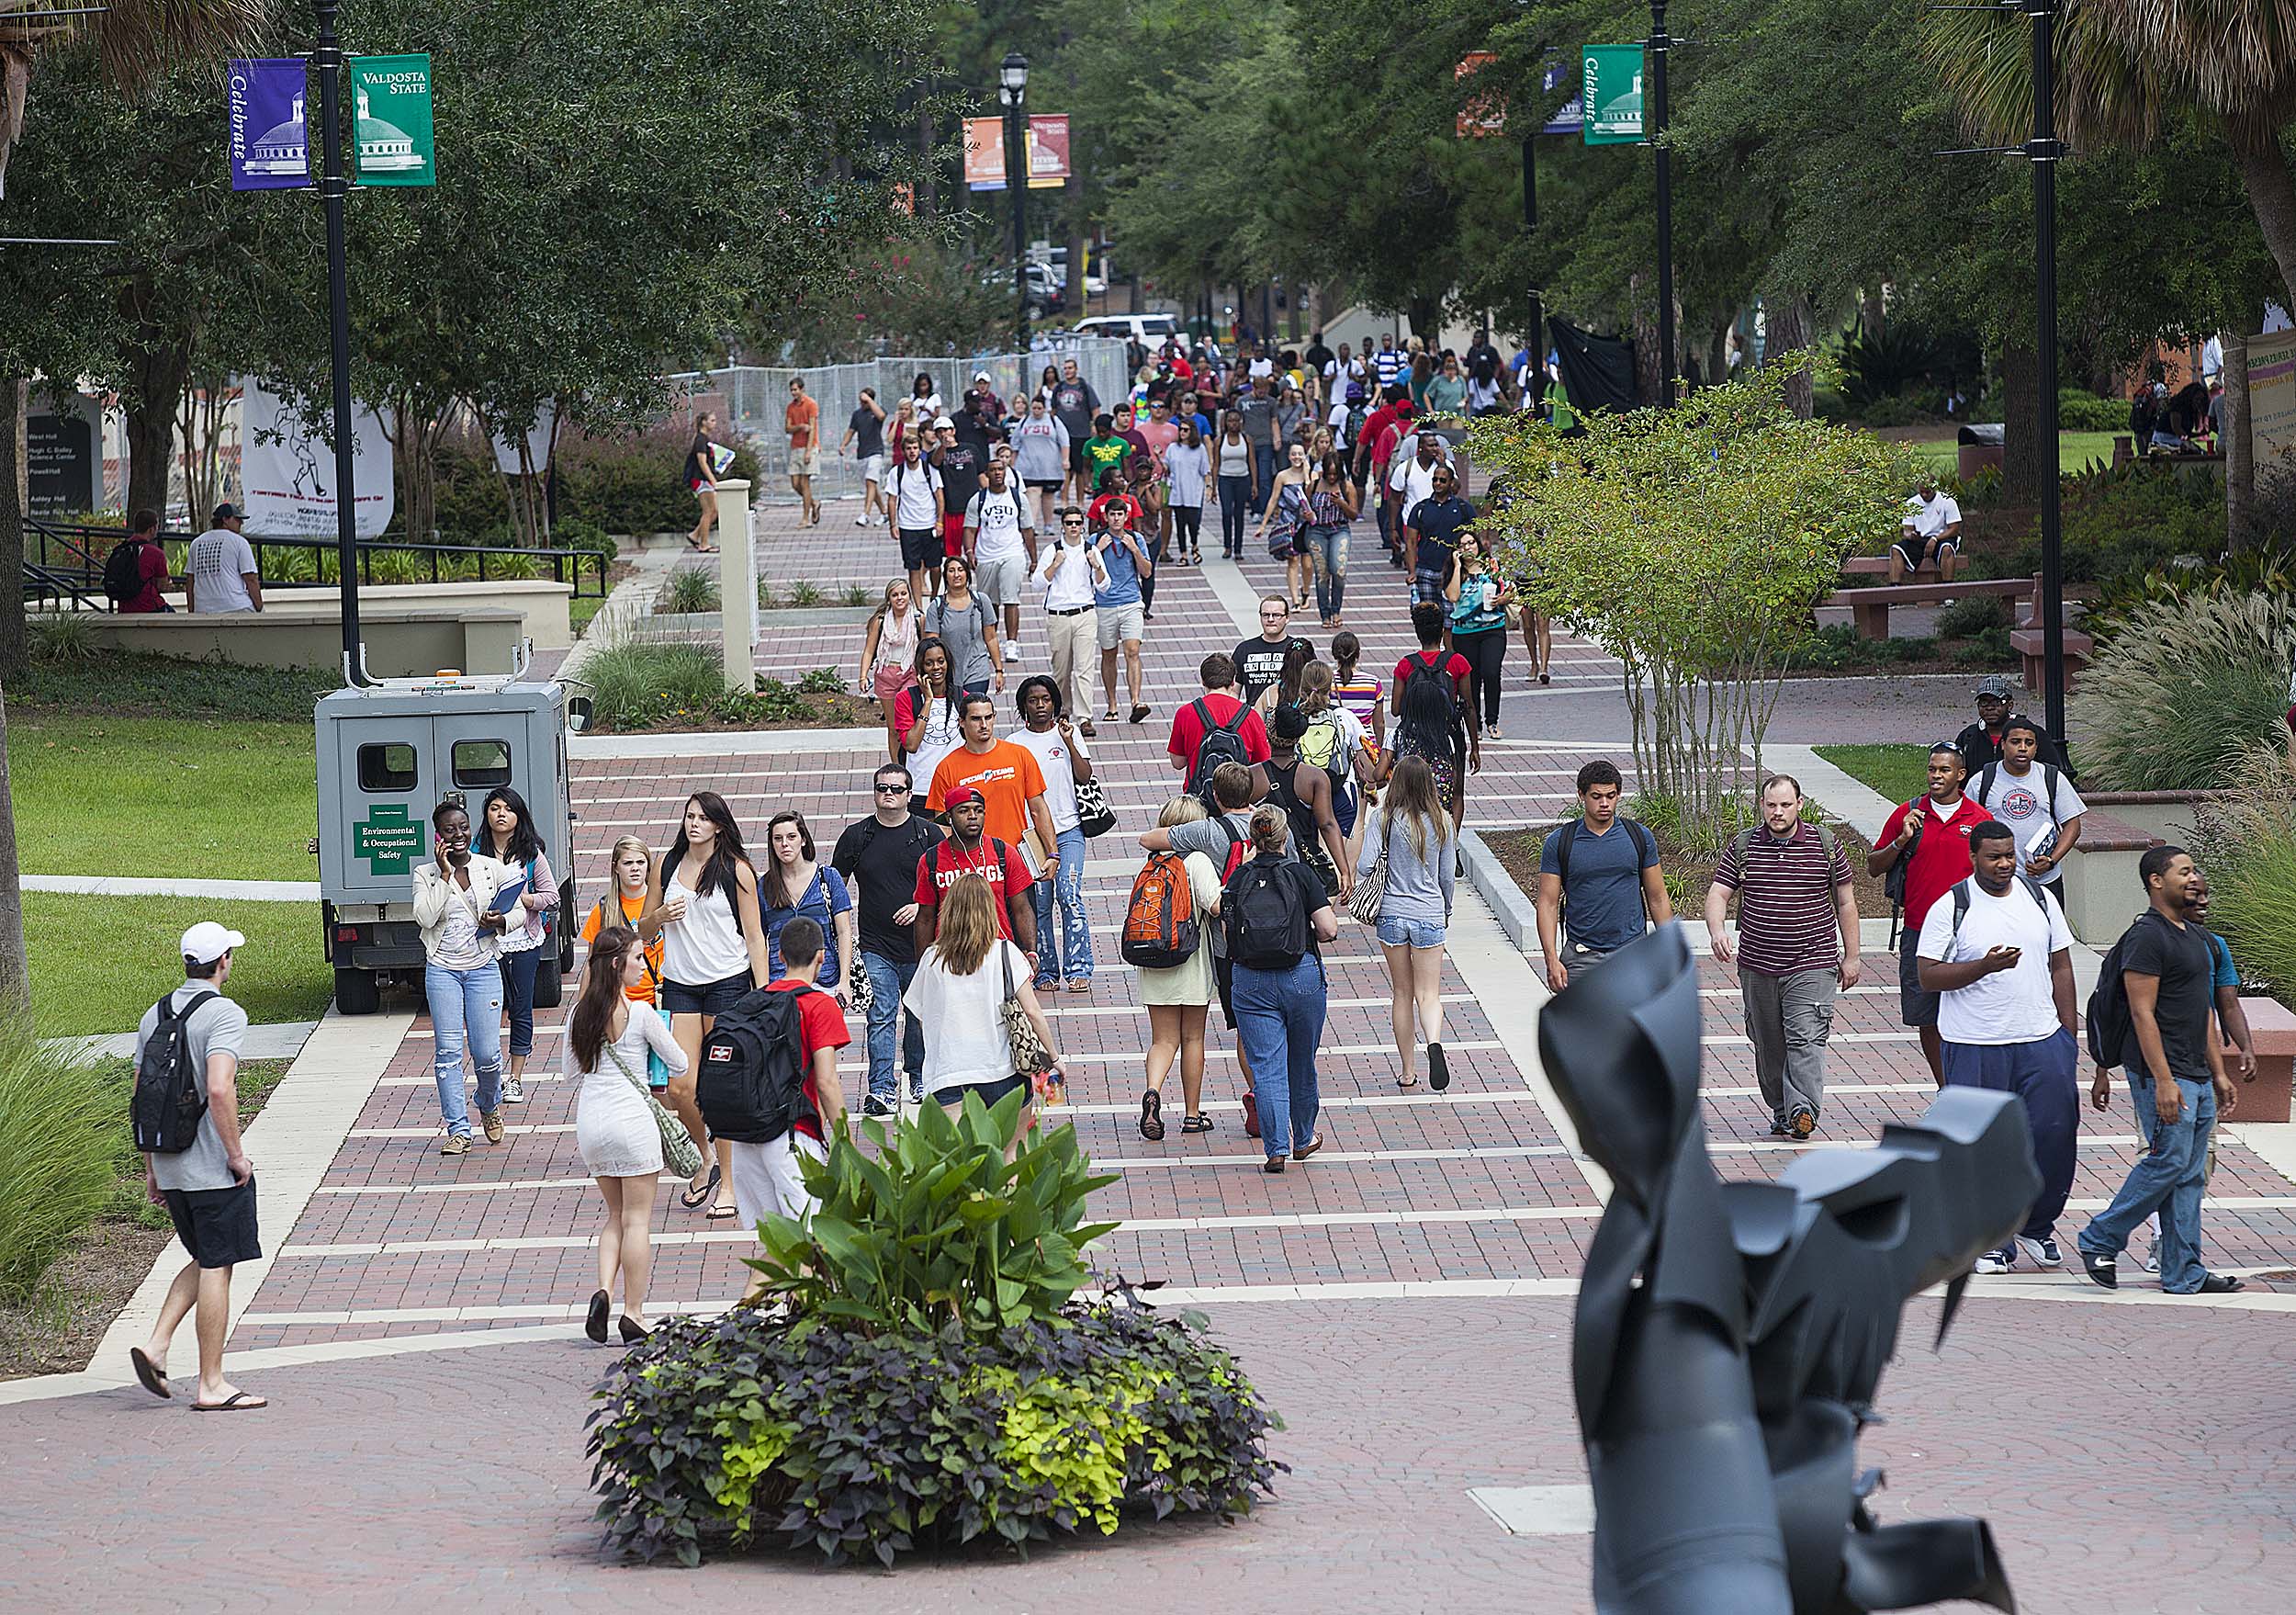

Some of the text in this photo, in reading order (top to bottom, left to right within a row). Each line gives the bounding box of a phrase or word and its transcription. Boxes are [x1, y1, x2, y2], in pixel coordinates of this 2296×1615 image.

[362, 72, 426, 85] VALDOSTA
[389, 83, 427, 95] STATE
[1585, 57, 1599, 122] Celebrate
[231, 74, 249, 160] Celebrate
[1024, 425, 1050, 435] VSU
[984, 505, 1013, 515] VSU
[362, 826, 416, 835] Environmental
[362, 838, 417, 849] & Occupational
[378, 851, 401, 860] Safety
